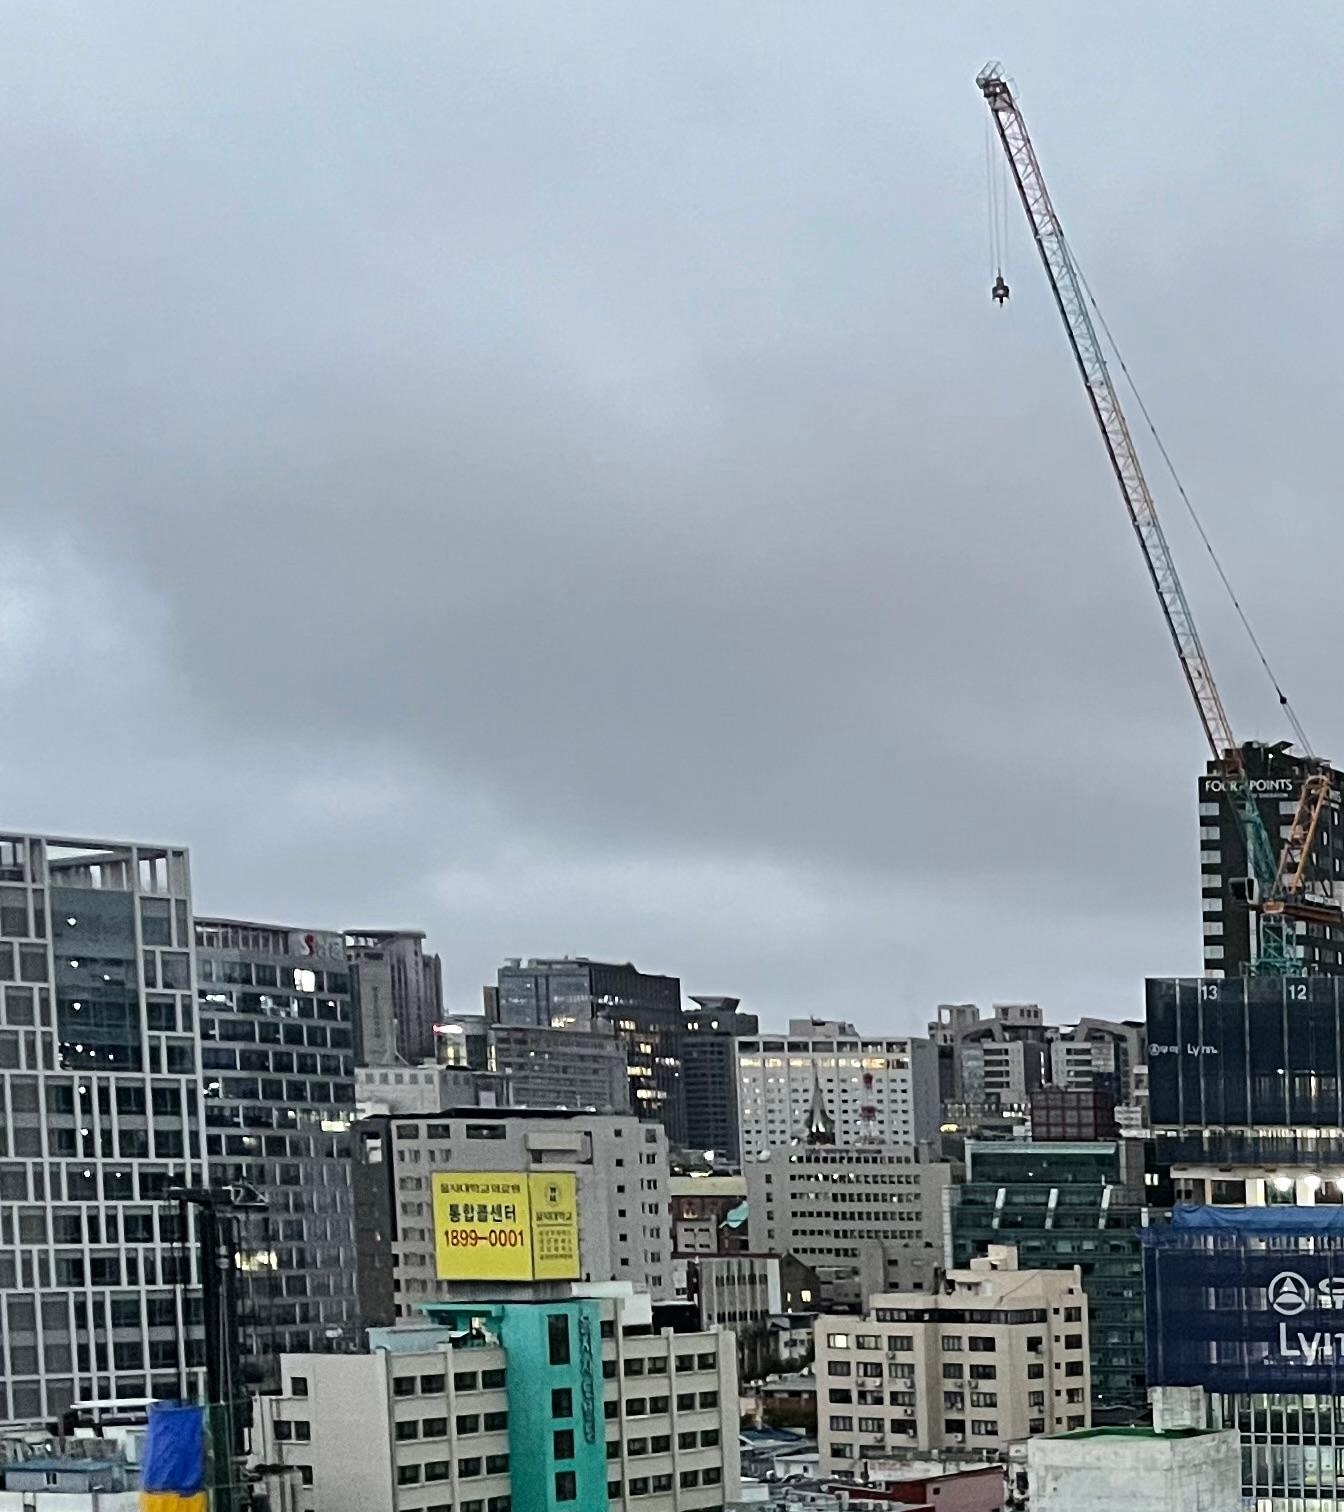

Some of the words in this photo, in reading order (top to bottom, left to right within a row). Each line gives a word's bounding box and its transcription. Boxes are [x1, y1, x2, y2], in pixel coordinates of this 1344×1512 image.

[1250, 778, 1293, 792] POINTS
[1201, 984, 1218, 1000] 13
[1289, 984, 1307, 1000] 12
[448, 1203, 516, 1224] 통합콜센터
[444, 1229, 525, 1247] 1899-0001
